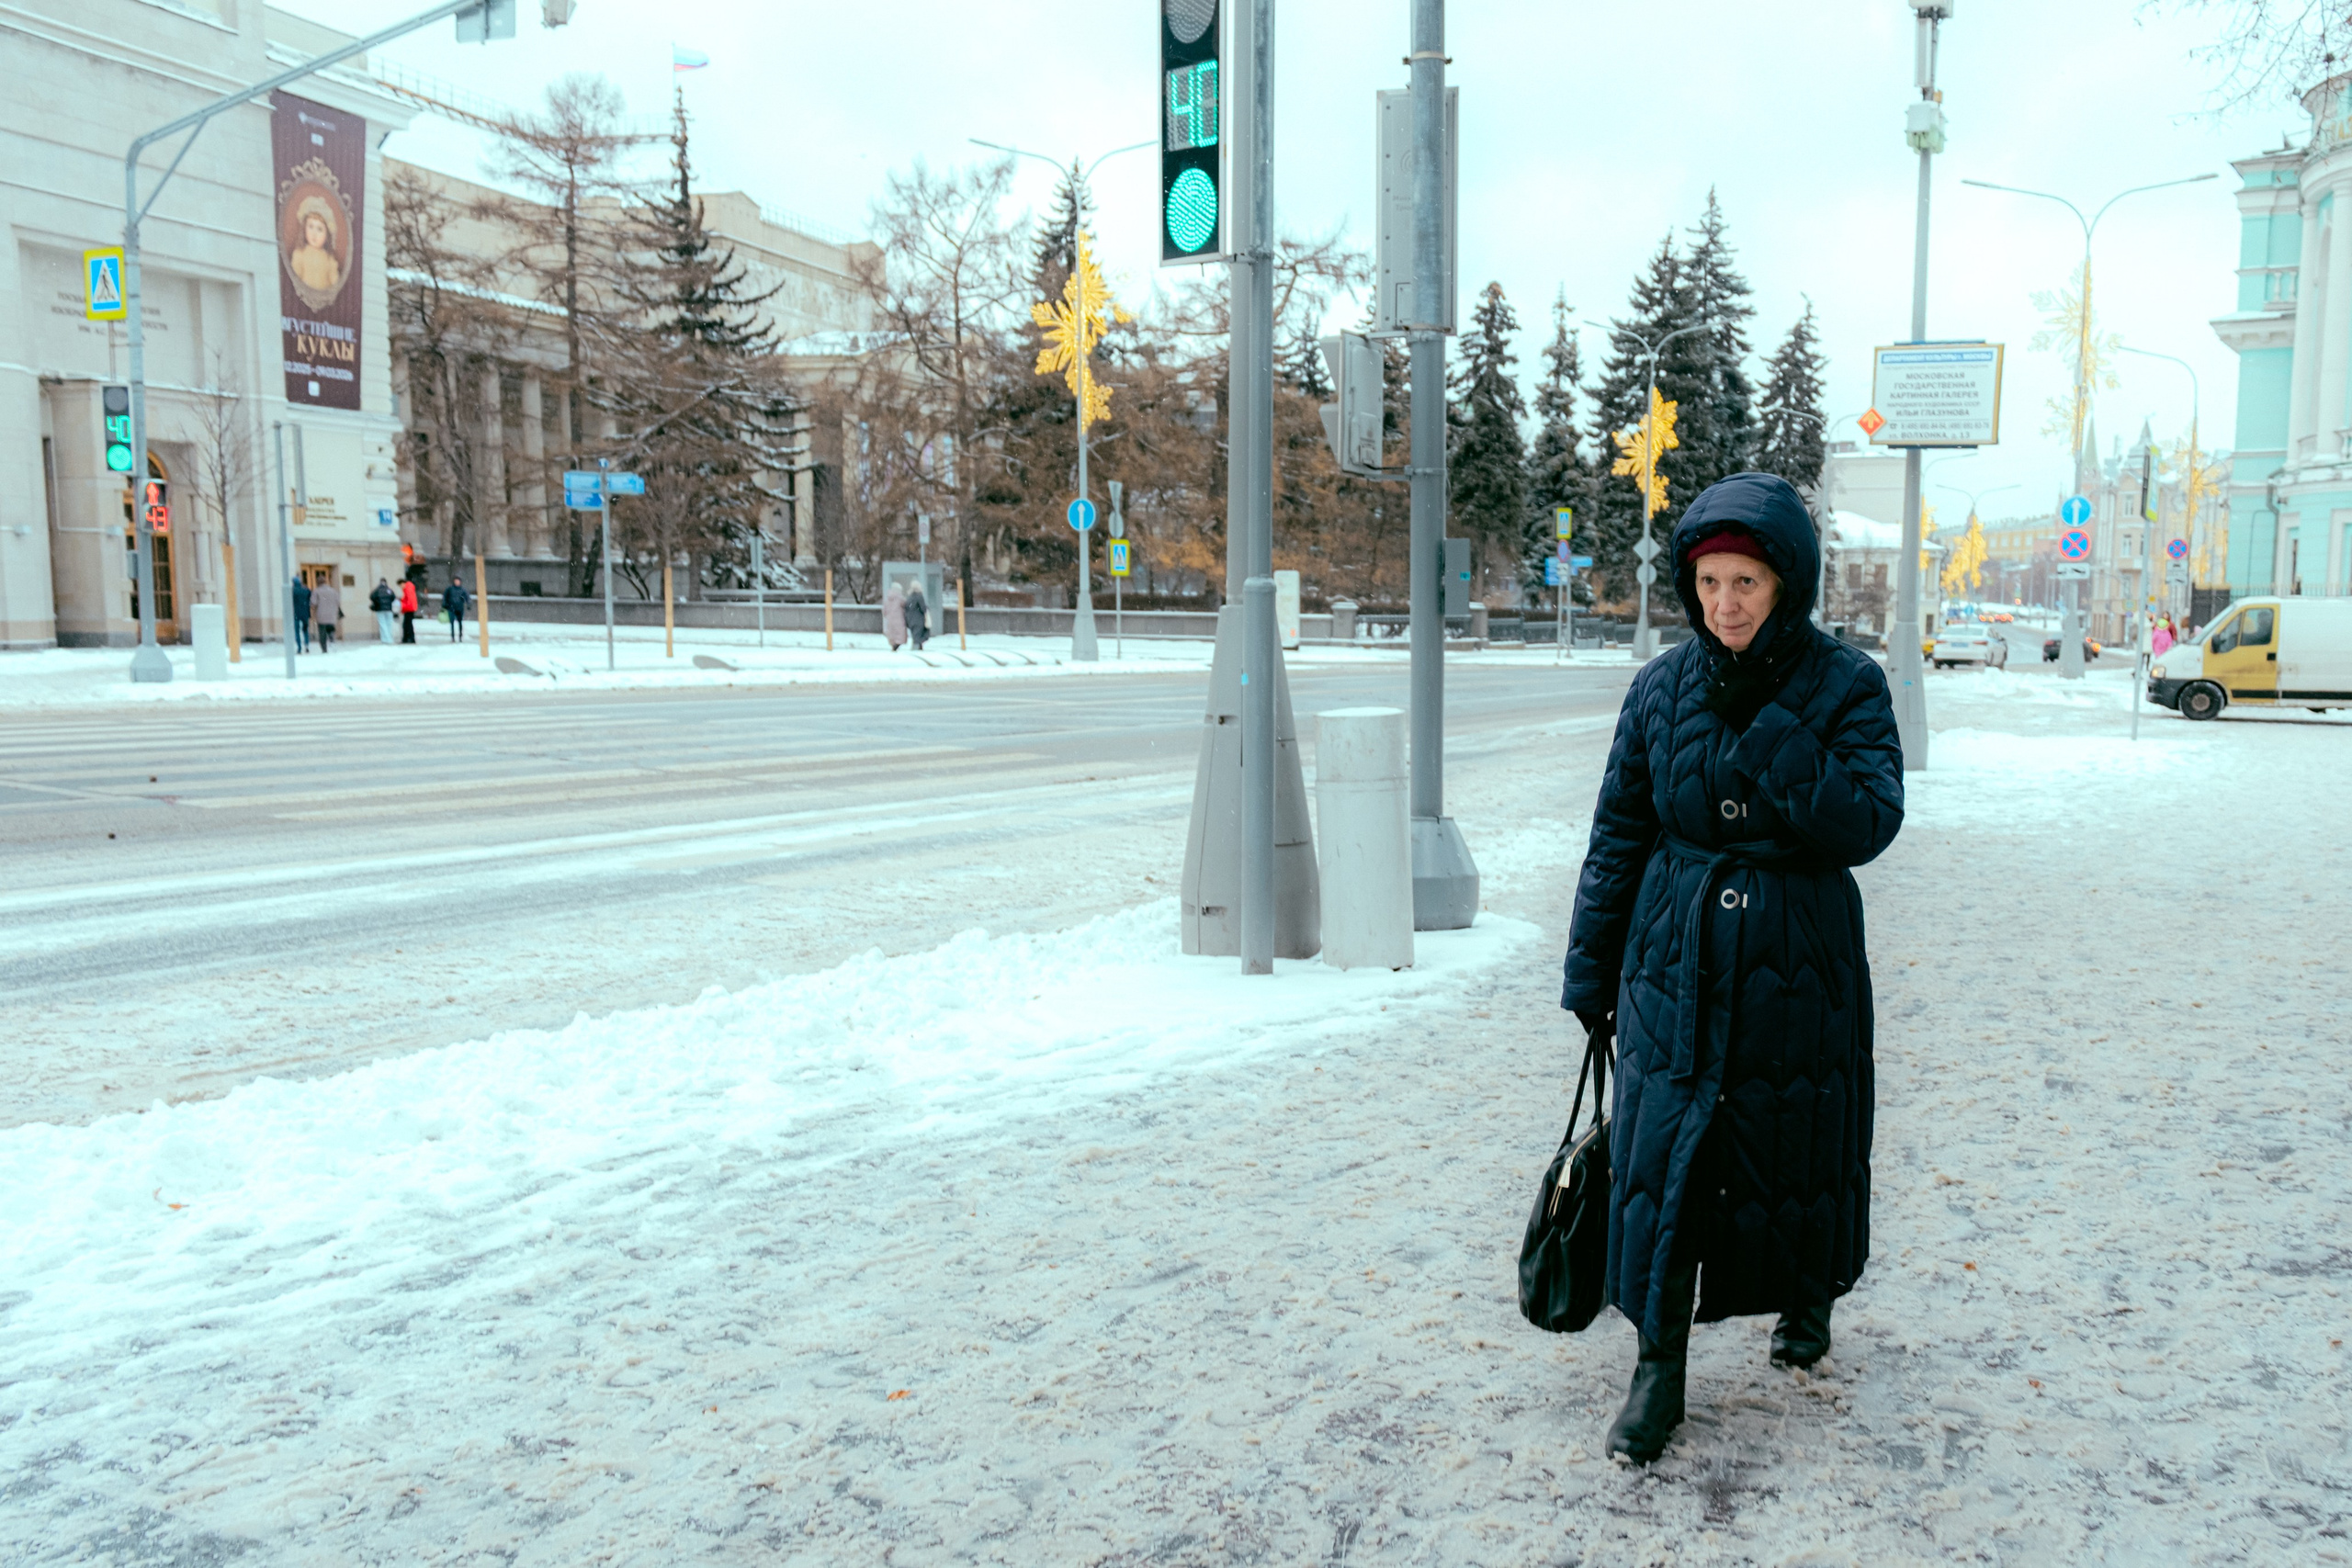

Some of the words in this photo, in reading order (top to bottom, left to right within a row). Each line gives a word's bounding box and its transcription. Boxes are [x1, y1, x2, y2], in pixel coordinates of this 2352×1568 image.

[1170, 60, 1218, 148] 40
[281, 316, 356, 343] ВГУСТЕЙШИЕ
[297, 333, 355, 363] КУКЛЫ
[1894, 381, 1975, 390] ГОСУДАРСТВЕННАЯ
[1905, 372, 1965, 380] МОСКОВСКАЯ
[1890, 391, 1939, 400] КАРТИННАЯ
[1941, 390, 1979, 399] ГАЛЕРЕЯ
[1921, 409, 1970, 417] ГЛАЗУНОВА
[107, 415, 131, 443] 40
[146, 506, 168, 532] 43
